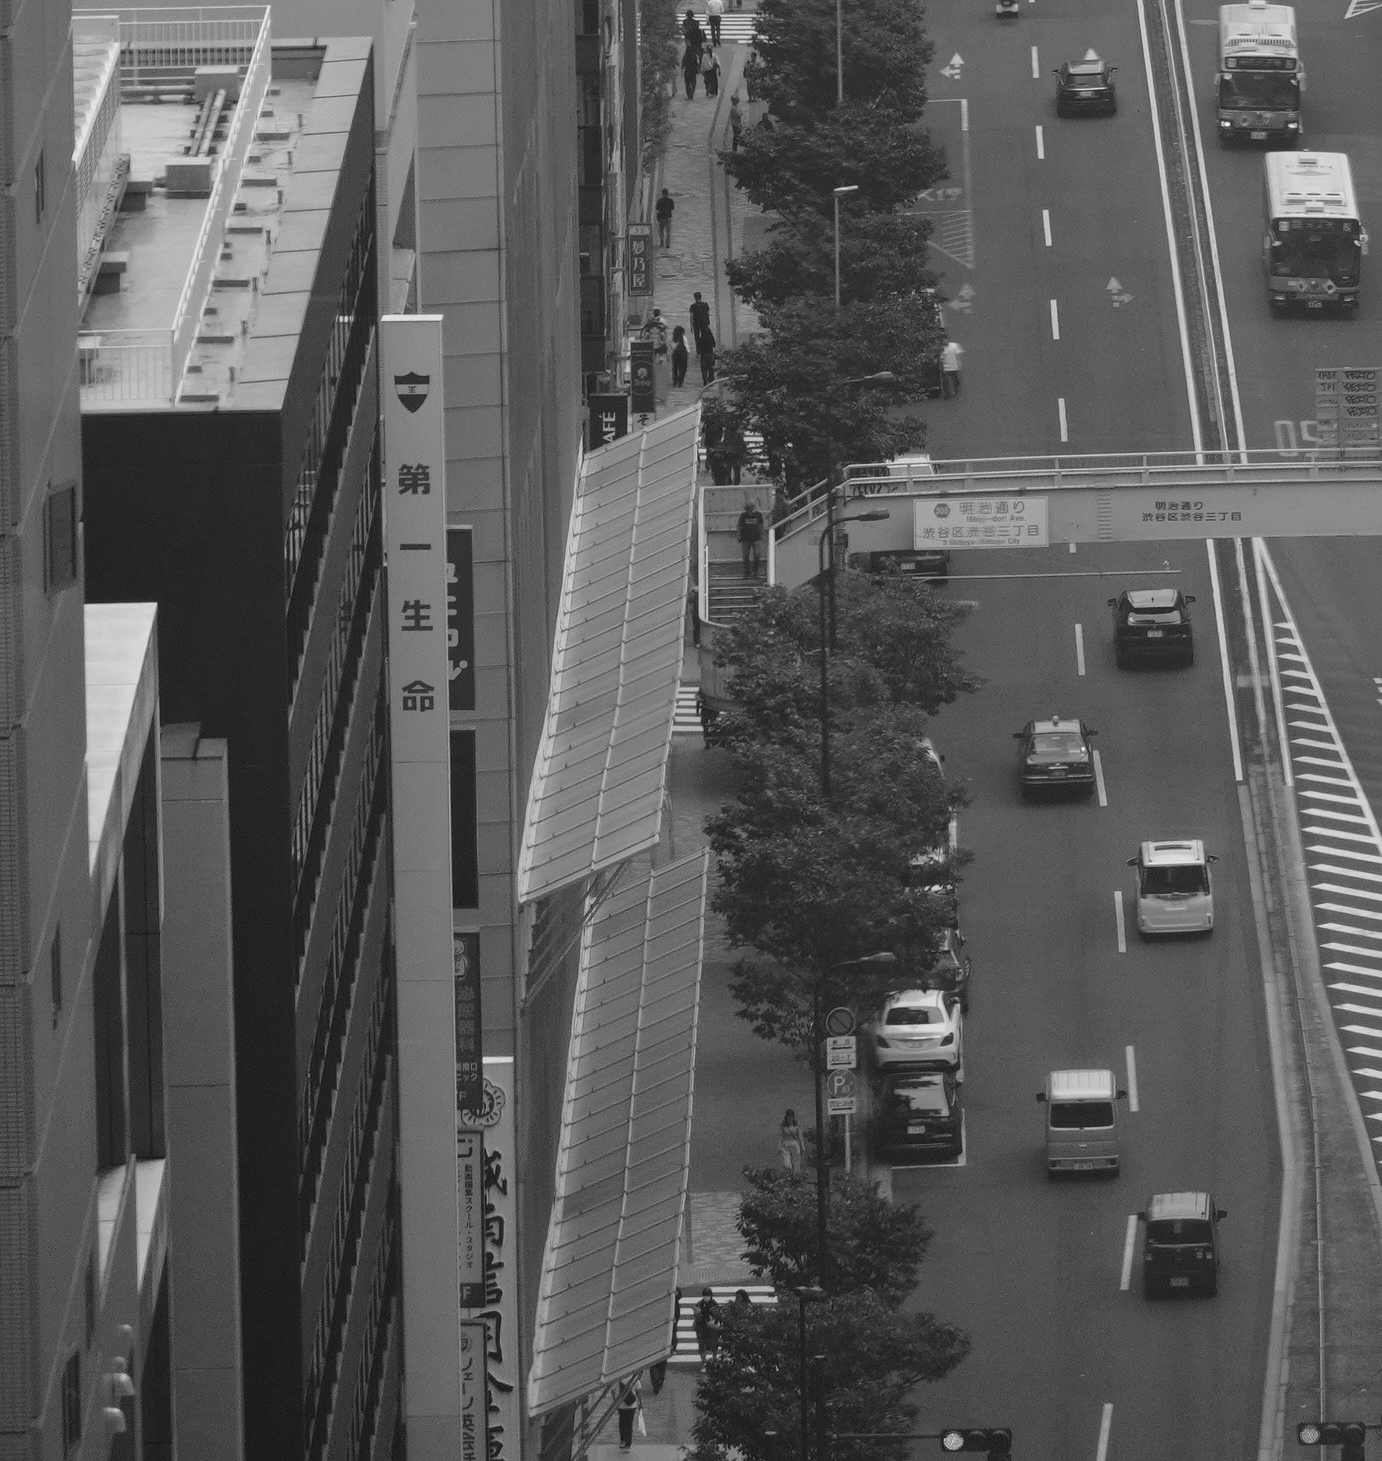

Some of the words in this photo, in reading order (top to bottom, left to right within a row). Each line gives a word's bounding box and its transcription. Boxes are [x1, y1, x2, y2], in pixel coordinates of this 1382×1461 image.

[959, 500, 1025, 515] 明治通り
[1154, 501, 1203, 511] 明治通り
[1142, 512, 1242, 522] 渋谷区渋谷三丁目
[922, 524, 1039, 539] 渋谷区渋谷三丁目
[397, 463, 435, 713] 第一生命
